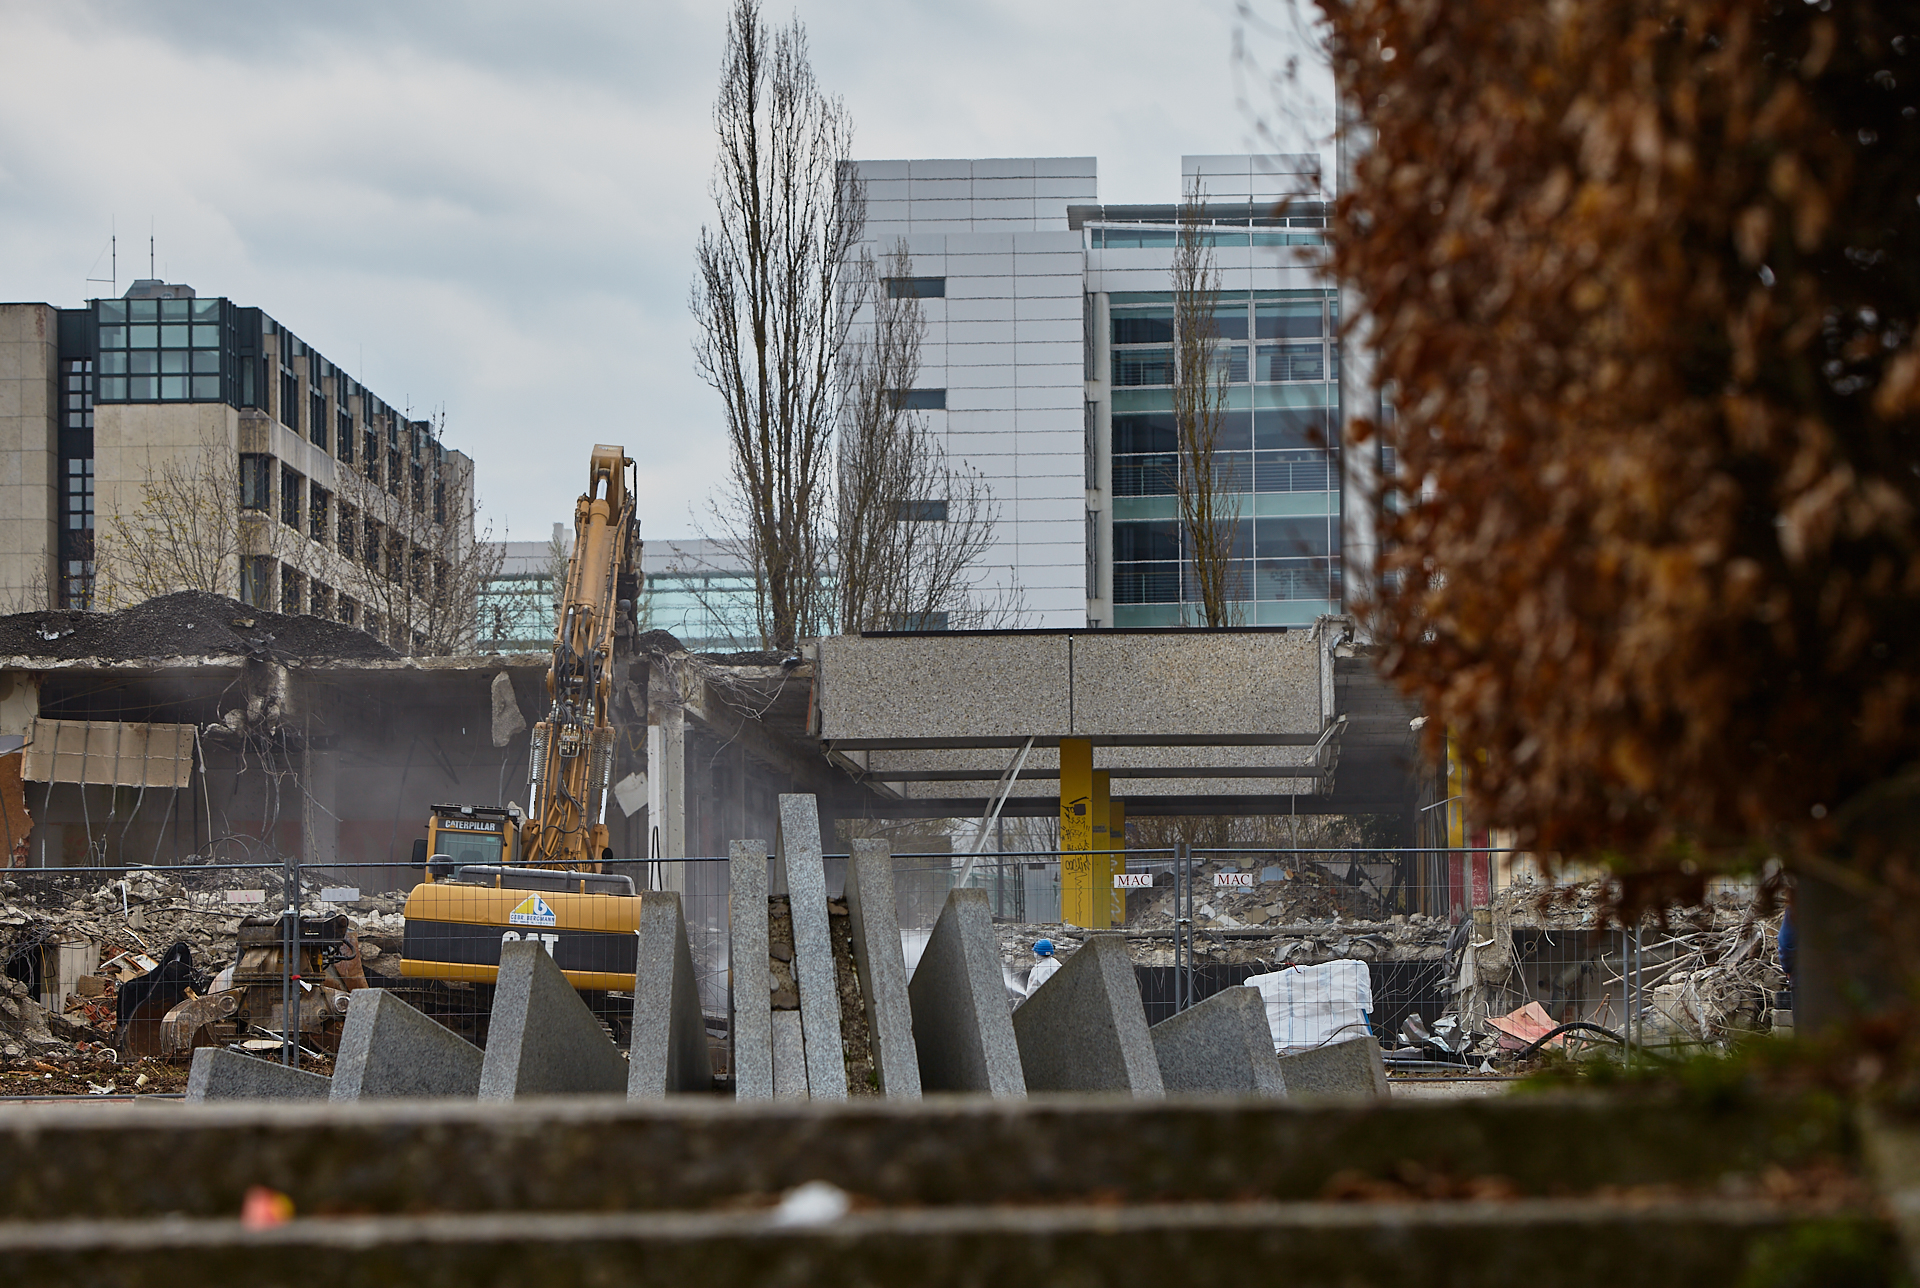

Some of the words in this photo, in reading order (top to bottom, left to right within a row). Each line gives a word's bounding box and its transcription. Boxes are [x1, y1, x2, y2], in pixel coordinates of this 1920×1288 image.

[445, 820, 496, 831] CATERPILLAR
[1118, 874, 1150, 886] MAC
[1218, 874, 1250, 885] MAC
